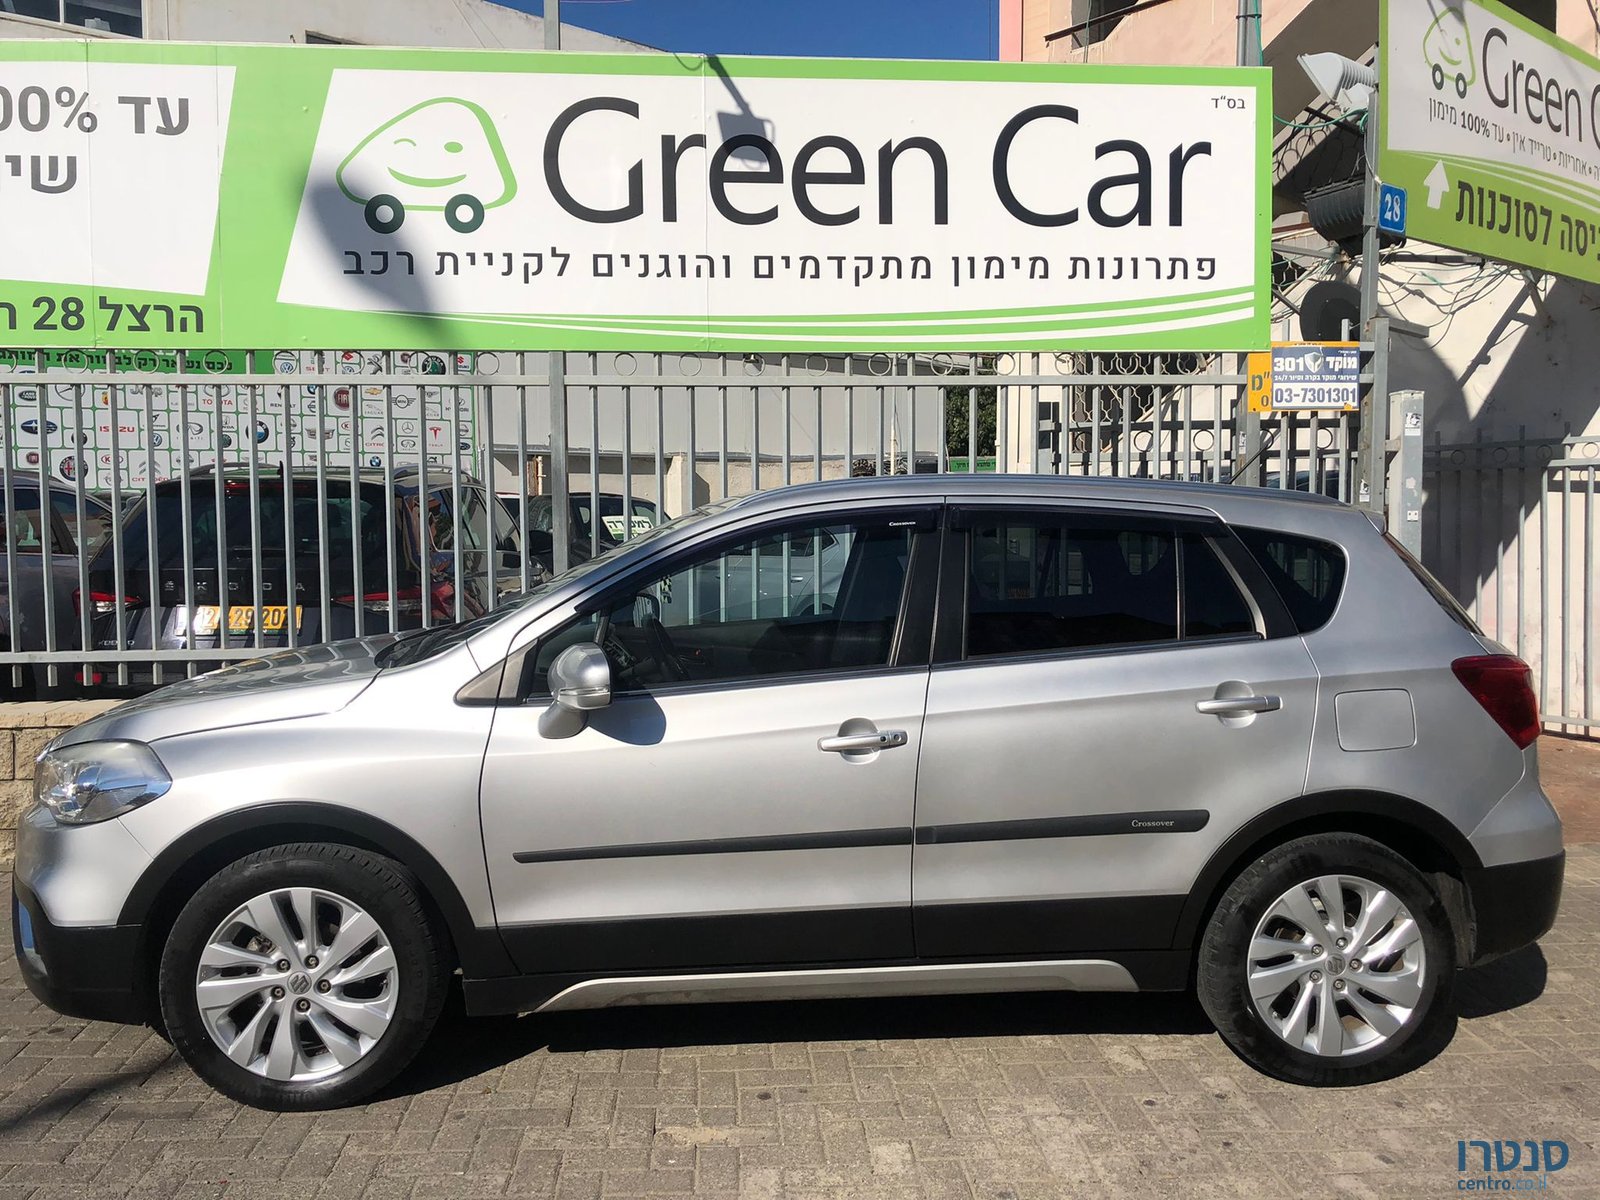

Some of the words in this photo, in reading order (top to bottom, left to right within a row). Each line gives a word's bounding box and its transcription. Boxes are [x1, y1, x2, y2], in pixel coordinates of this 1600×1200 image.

[1482, 27, 1583, 143] Green
[117, 96, 190, 136] עד
[1429, 98, 1457, 126] מימון
[1461, 111, 1490, 138] 100%
[1492, 123, 1505, 143] עד
[1512, 131, 1526, 154] אין
[543, 96, 949, 226] Green
[992, 103, 1213, 228] Car
[1528, 138, 1552, 162] טרייד
[1558, 151, 1588, 177] אחריות
[1383, 193, 1400, 222] 28
[1455, 180, 1553, 246] לסוכנות
[1560, 213, 1600, 261] יסה
[342, 250, 415, 275] רכב
[434, 246, 570, 284] לקניית
[592, 253, 731, 279] והוגנים
[753, 255, 931, 287] מתקדמים
[951, 255, 1049, 287] מימון
[1067, 256, 1216, 281] פתרונות
[32, 296, 85, 331] 28
[98, 295, 204, 333] הרצל
[1273, 357, 1304, 372] 301
[1274, 387, 1357, 403] 03-7301301
[99, 425, 135, 433] ISZU
[1131, 819, 1175, 828] Crossover
